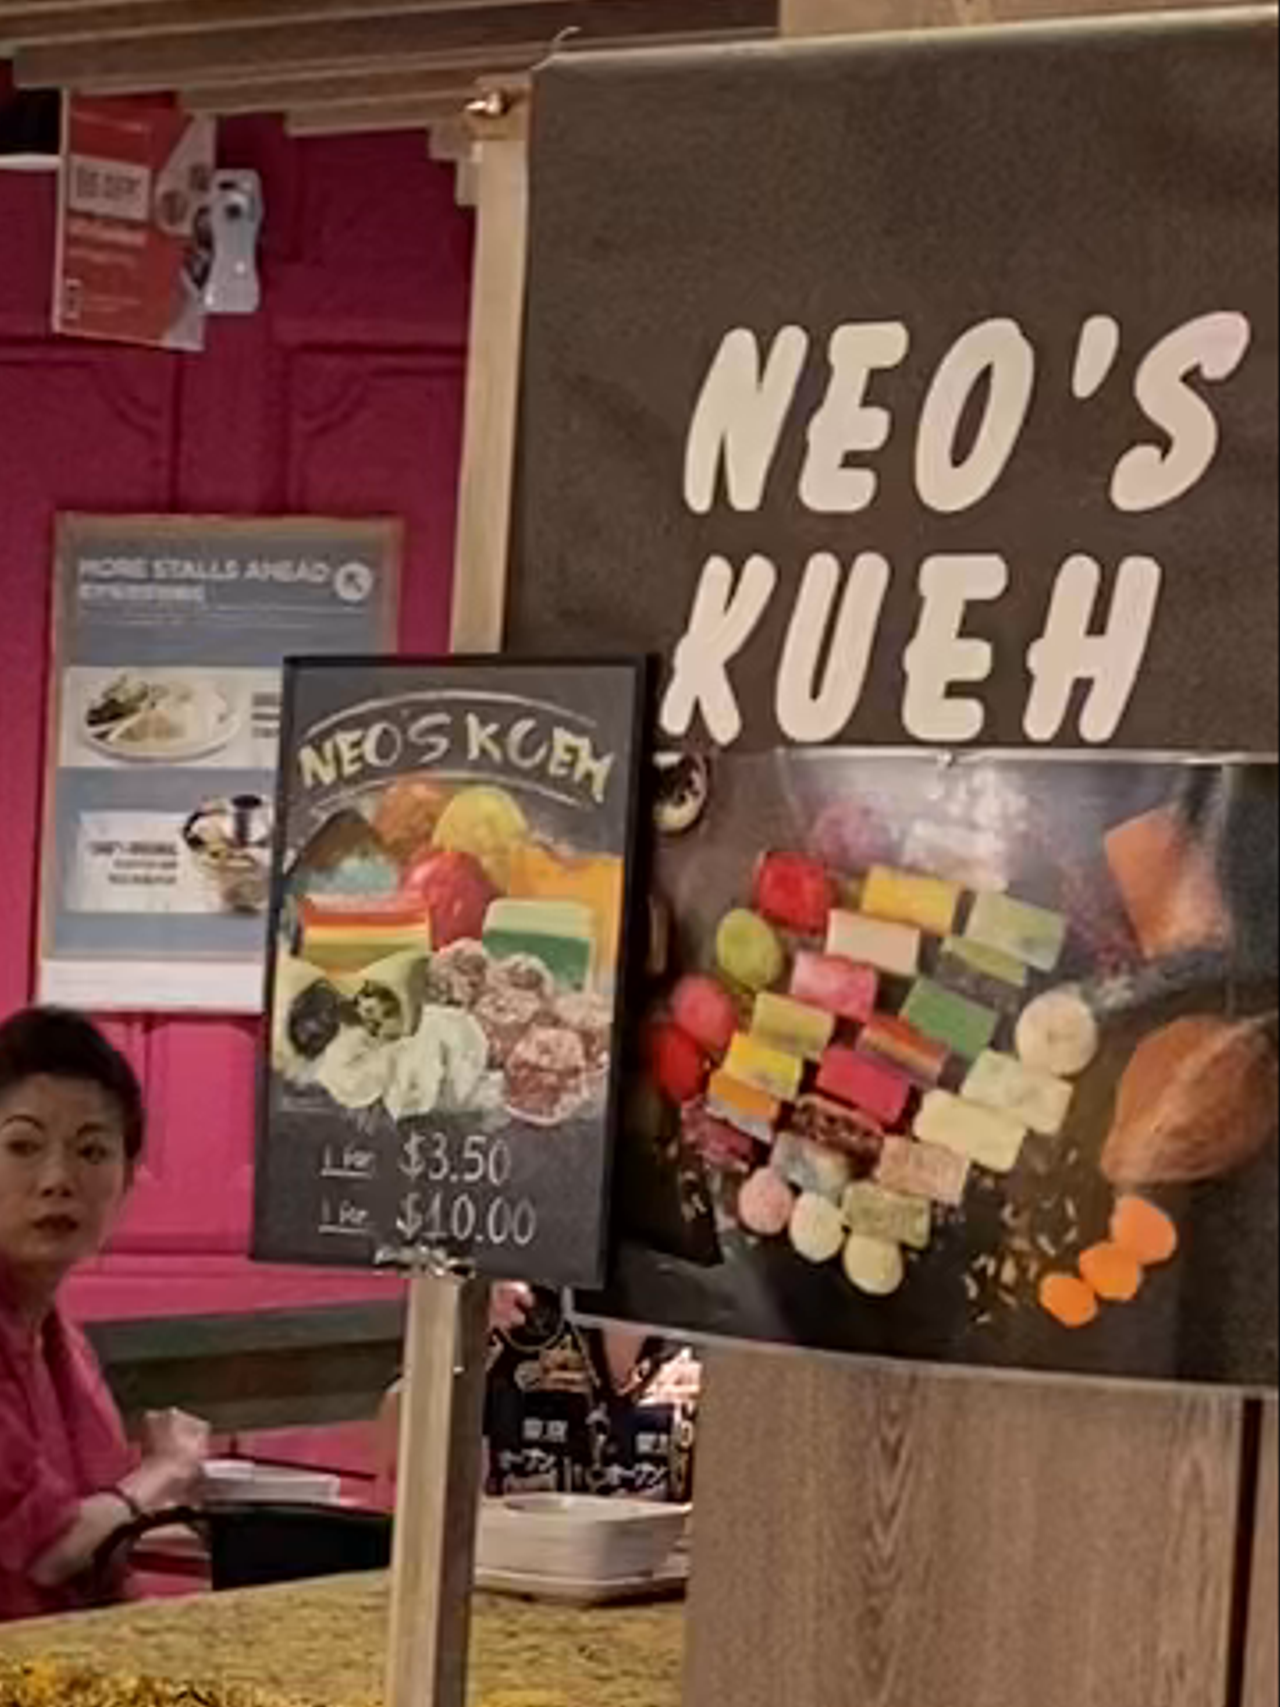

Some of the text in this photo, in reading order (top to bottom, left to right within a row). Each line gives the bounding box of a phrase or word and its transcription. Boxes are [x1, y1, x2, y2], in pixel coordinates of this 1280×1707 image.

[683, 310, 1251, 515] NEO'S
[151, 558, 239, 581] STALLS
[242, 560, 332, 584] AHEAD
[659, 551, 1162, 746] KUEH
[398, 1130, 513, 1187] $3.50
[395, 1191, 538, 1246] $10.00
